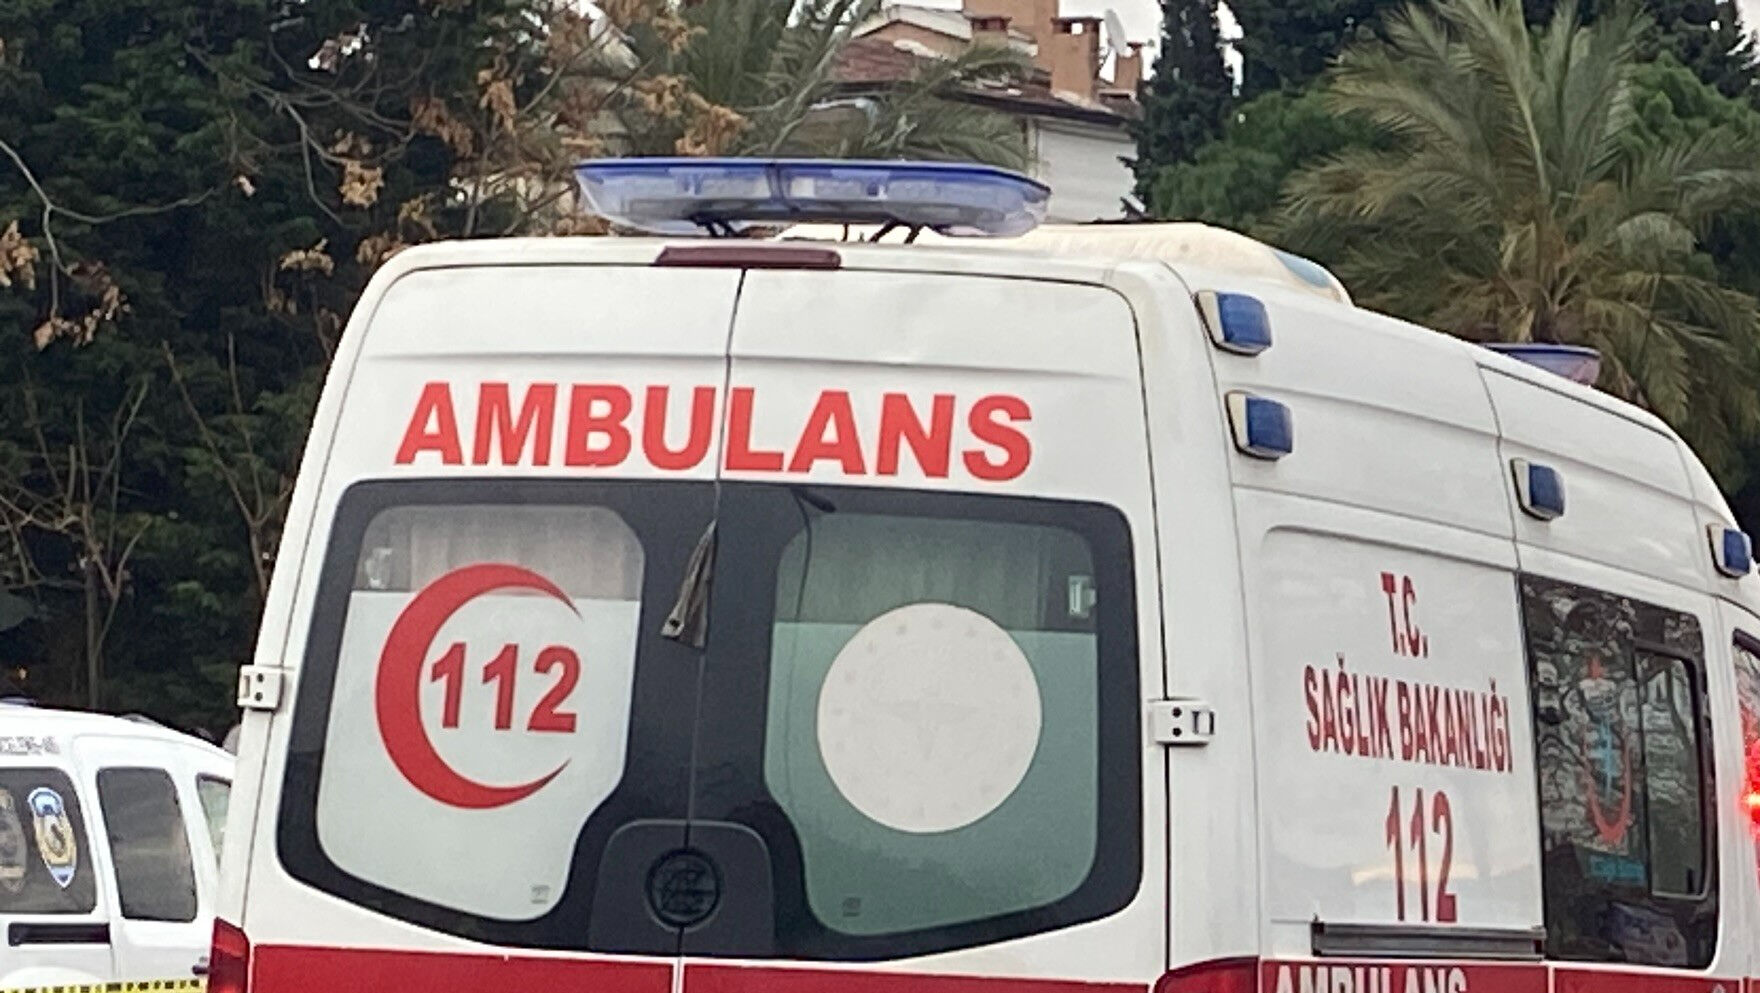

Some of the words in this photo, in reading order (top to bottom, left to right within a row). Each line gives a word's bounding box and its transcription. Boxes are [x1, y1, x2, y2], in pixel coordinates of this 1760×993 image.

[395, 382, 1033, 482] AMBULANS
[1381, 570, 1428, 659] T.C.
[430, 642, 581, 734] 112
[1304, 651, 1395, 760] SAĞLIK
[1399, 677, 1513, 774] BAKANLIĞI
[1385, 785, 1458, 924] 112
